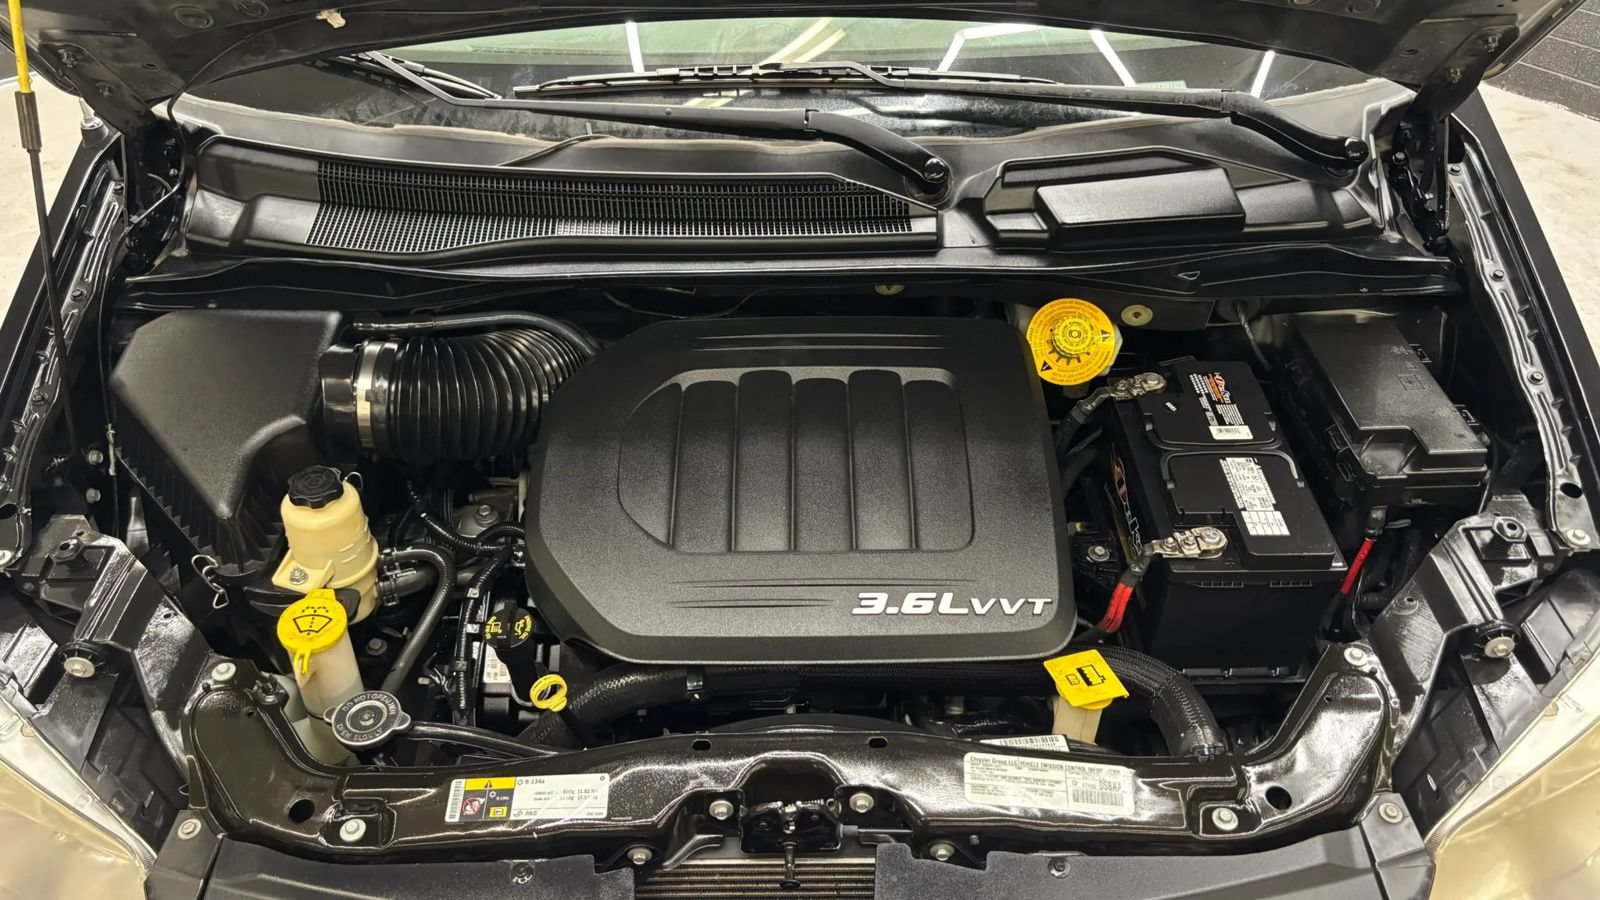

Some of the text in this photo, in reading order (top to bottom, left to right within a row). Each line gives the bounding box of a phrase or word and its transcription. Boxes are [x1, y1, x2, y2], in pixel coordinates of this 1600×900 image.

[851, 592, 1053, 615] 3.6L VVT
[342, 701, 354, 712] DO
[354, 693, 371, 703] NOT
[353, 727, 382, 742] SLOWLY
[970, 756, 990, 764] Chrysler
[992, 758, 1007, 766] Group
[1020, 760, 1039, 768] VEHICLE
[1041, 762, 1064, 770] EMISSION
[1065, 764, 1086, 772] CONTROL
